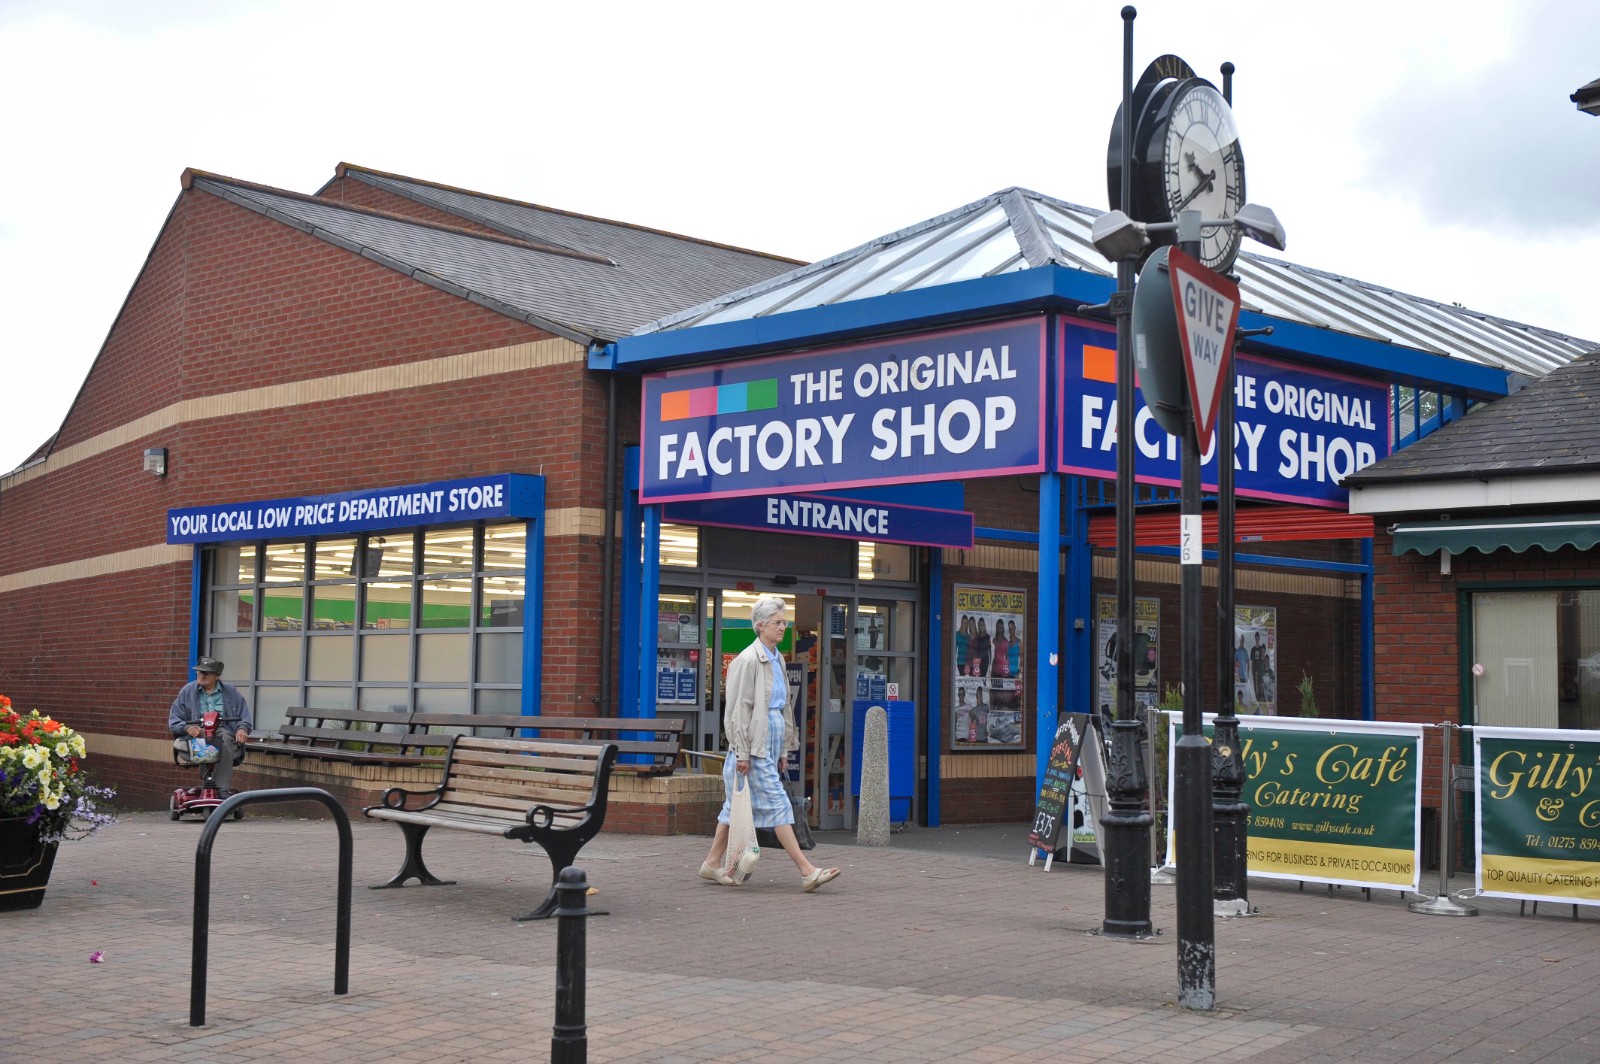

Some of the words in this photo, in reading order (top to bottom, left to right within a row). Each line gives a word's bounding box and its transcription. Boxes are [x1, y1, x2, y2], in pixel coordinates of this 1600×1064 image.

[1184, 280, 1225, 336] GIVE
[1192, 331, 1219, 367] WAY
[790, 367, 843, 406] THE
[853, 344, 1017, 399] ORIGINAL
[1234, 375, 1257, 410] HE
[1264, 380, 1376, 431] ORIGINAL
[658, 412, 856, 481] FACTORY
[870, 394, 1017, 462] SHOP
[1081, 394, 1267, 473] FACY
[171, 513, 208, 536] YOUR
[211, 510, 254, 533] LOCAL
[257, 506, 292, 530] LOW
[294, 502, 336, 526] PRICE
[338, 490, 444, 522] DEPARTMENT
[448, 484, 504, 512] STORE
[766, 497, 889, 535] ENTRANCE
[1241, 739, 1298, 780] ly's
[1315, 742, 1409, 788] Café
[1254, 781, 1363, 814] Catering
[1535, 797, 1565, 822] &
[1254, 817, 1285, 829] 859408
[1291, 821, 1375, 837] www.gillyscafe.co.uk
[1548, 836, 1575, 849] 01275
[1246, 849, 1265, 863] RING
[1266, 851, 1282, 863] FOR
[1284, 853, 1318, 867] BUSINESS
[1320, 856, 1326, 867] &
[1328, 857, 1359, 870] PRIVATE
[1361, 860, 1411, 875] OCCASIONS
[1487, 868, 1504, 882] TOP
[1506, 870, 1543, 884] QUALITY
[1545, 872, 1592, 888] CATERING
